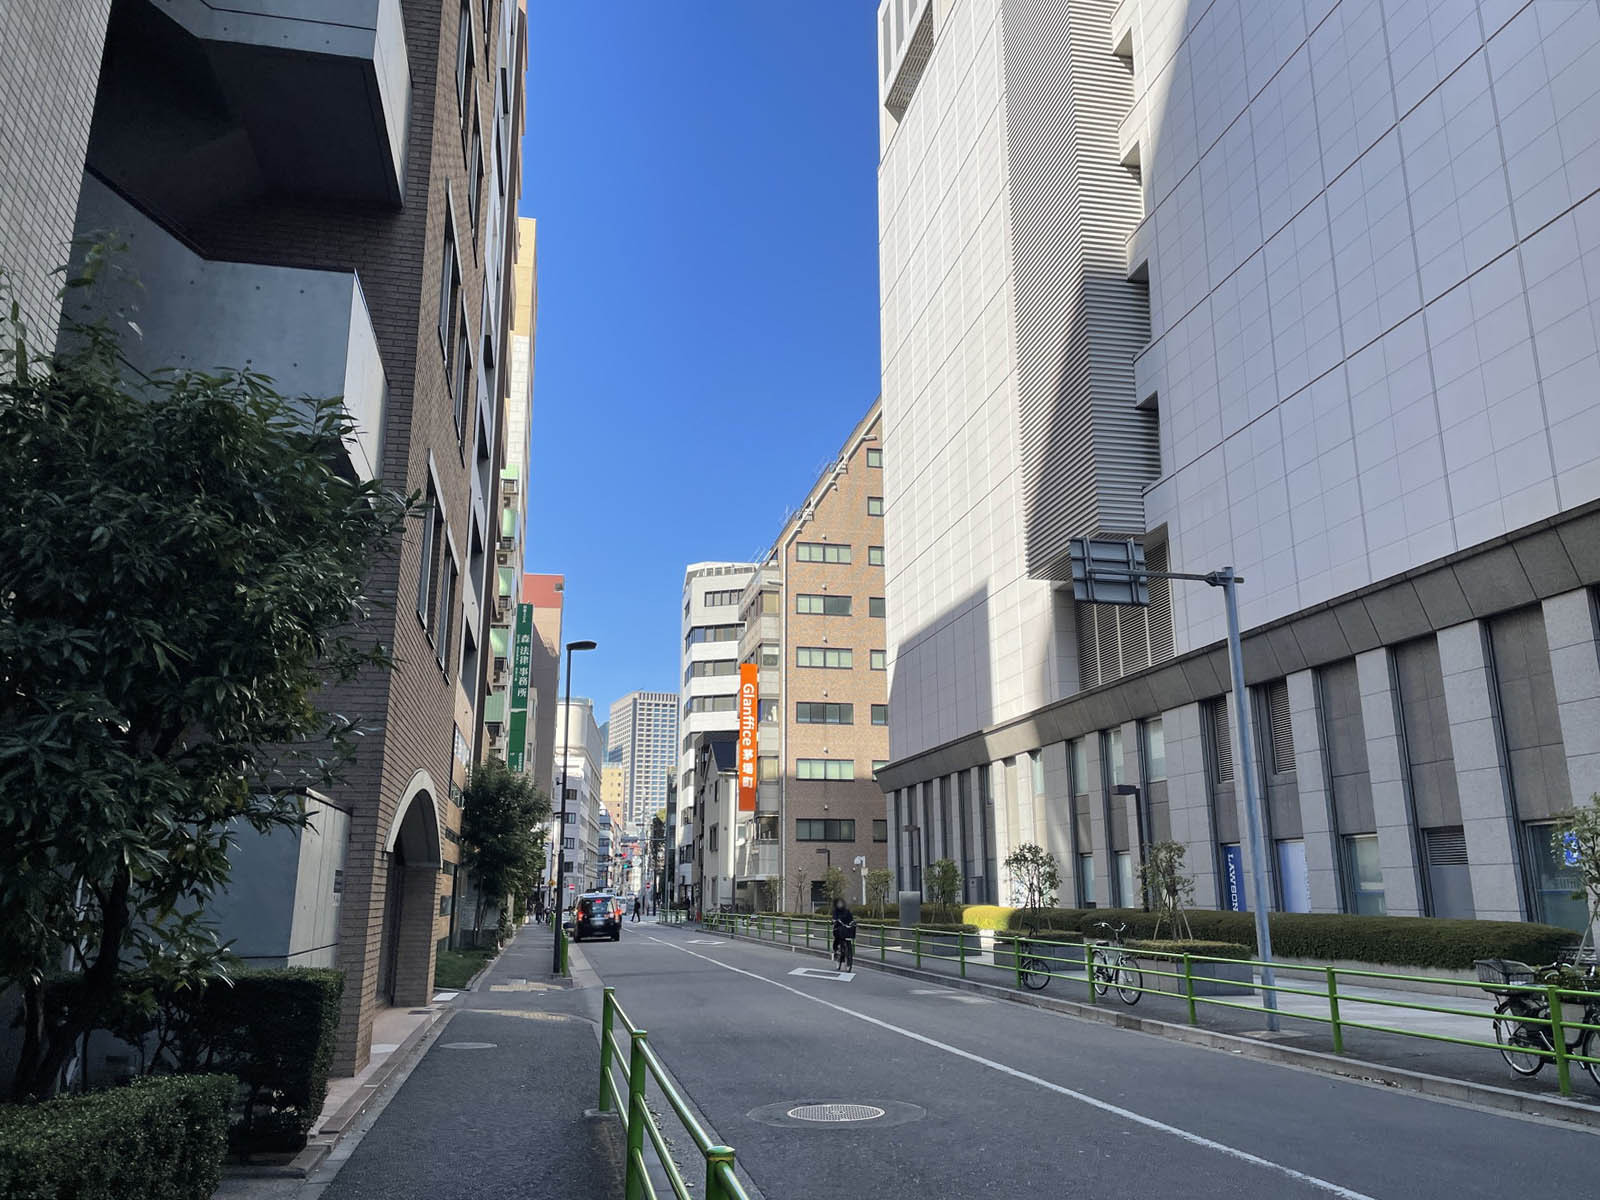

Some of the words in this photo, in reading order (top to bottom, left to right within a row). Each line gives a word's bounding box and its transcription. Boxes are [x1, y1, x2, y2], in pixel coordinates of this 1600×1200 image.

[517, 634, 530, 697] 森法律事務所
[742, 683, 755, 746] Glanffice
[1227, 853, 1239, 912] LAWSON
